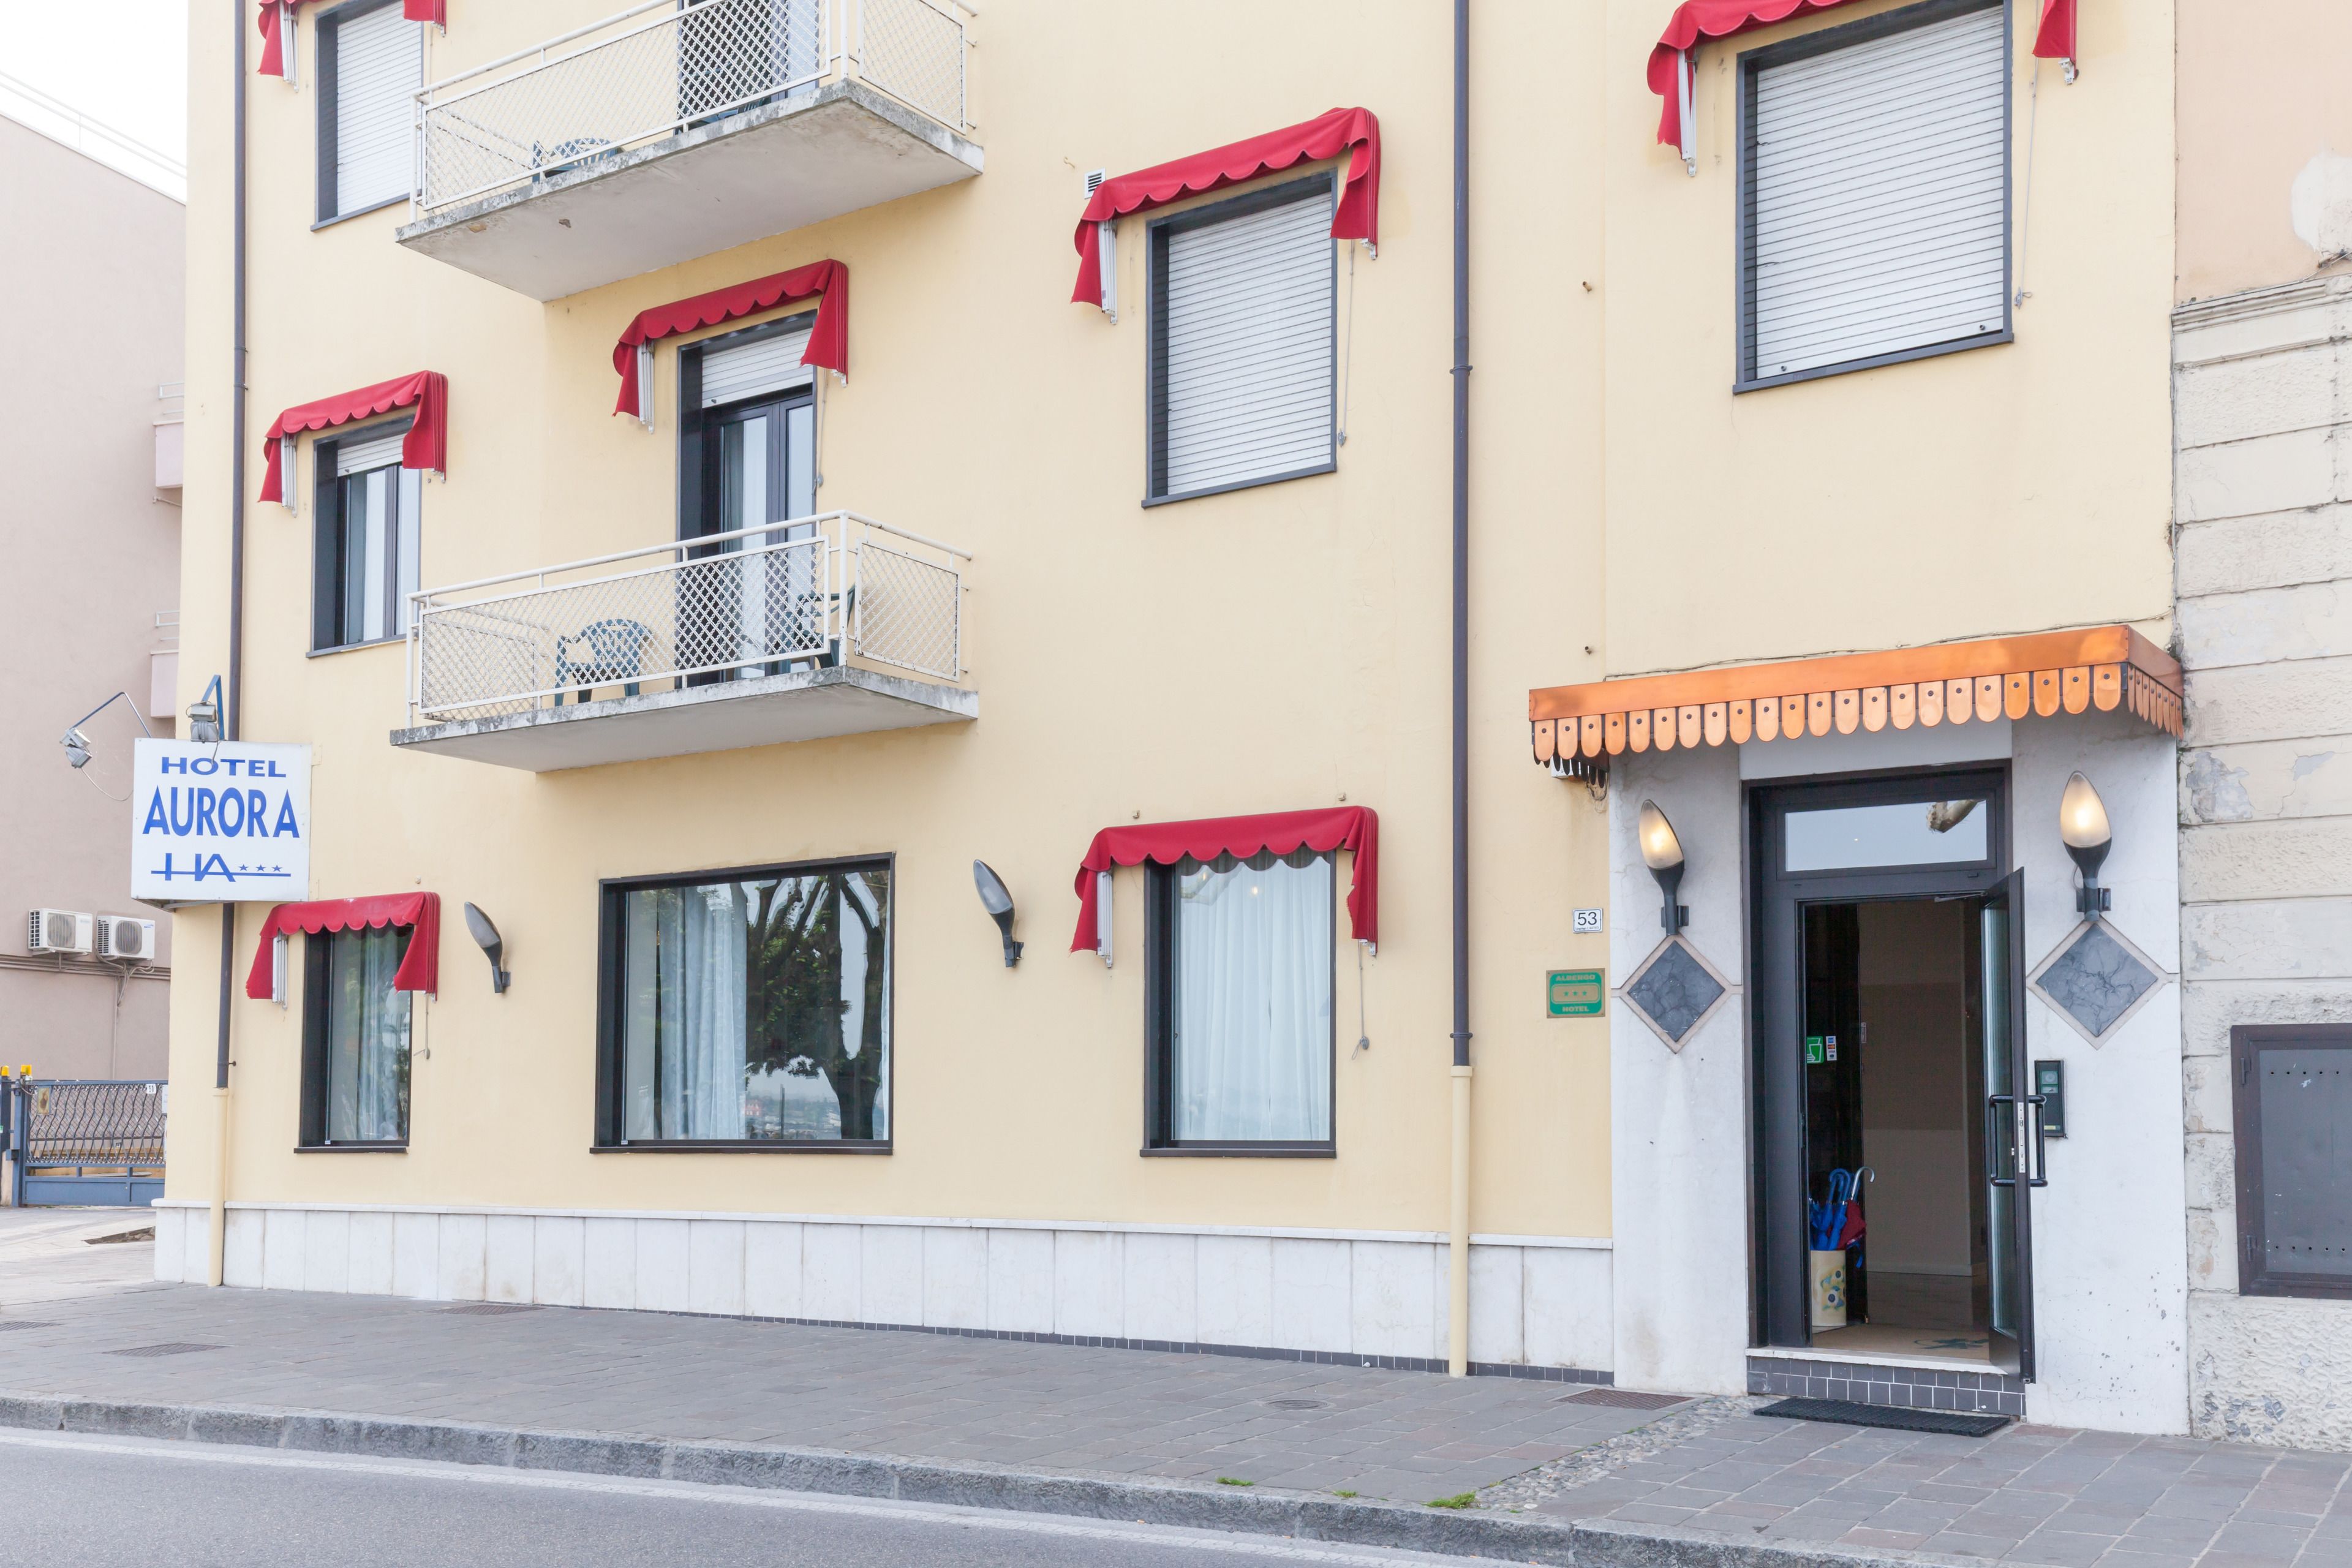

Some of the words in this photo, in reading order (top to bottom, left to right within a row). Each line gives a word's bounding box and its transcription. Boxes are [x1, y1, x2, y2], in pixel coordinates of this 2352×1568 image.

[161, 756, 287, 778] HOTEL
[142, 785, 300, 839] AURORA
[1578, 911, 1597, 925] 53
